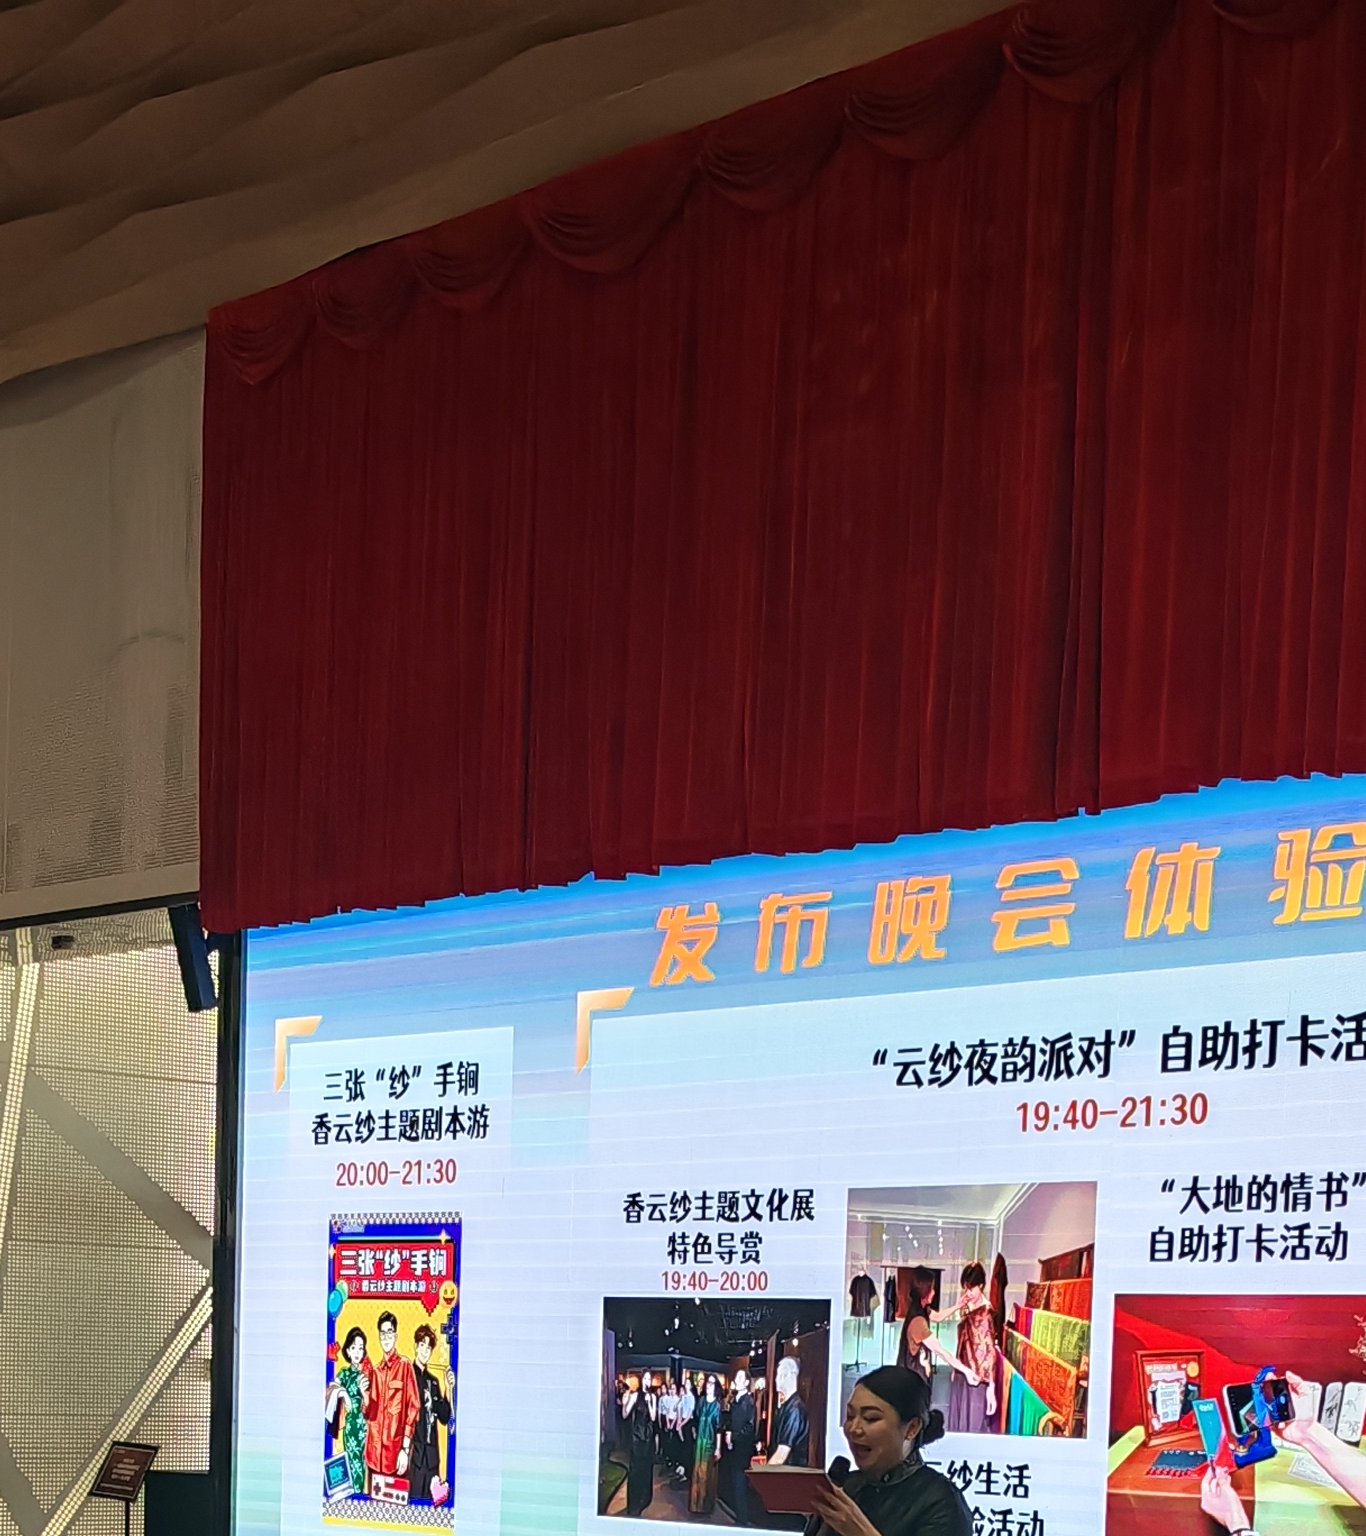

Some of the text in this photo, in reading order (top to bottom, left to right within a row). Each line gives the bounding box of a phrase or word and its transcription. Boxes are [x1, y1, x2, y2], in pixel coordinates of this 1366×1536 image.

[310, 1104, 489, 1146] 香云纱主题剧本游
[1017, 1090, 1207, 1136] 19:40-21:30
[336, 1160, 456, 1187] 20:00-21:30
[623, 1188, 814, 1223] 香云纱主题文化展
[667, 1231, 763, 1264] 特色导赏
[1149, 1221, 1348, 1263] 自助打卡活动
[662, 1271, 768, 1291] 19:40-20:00
